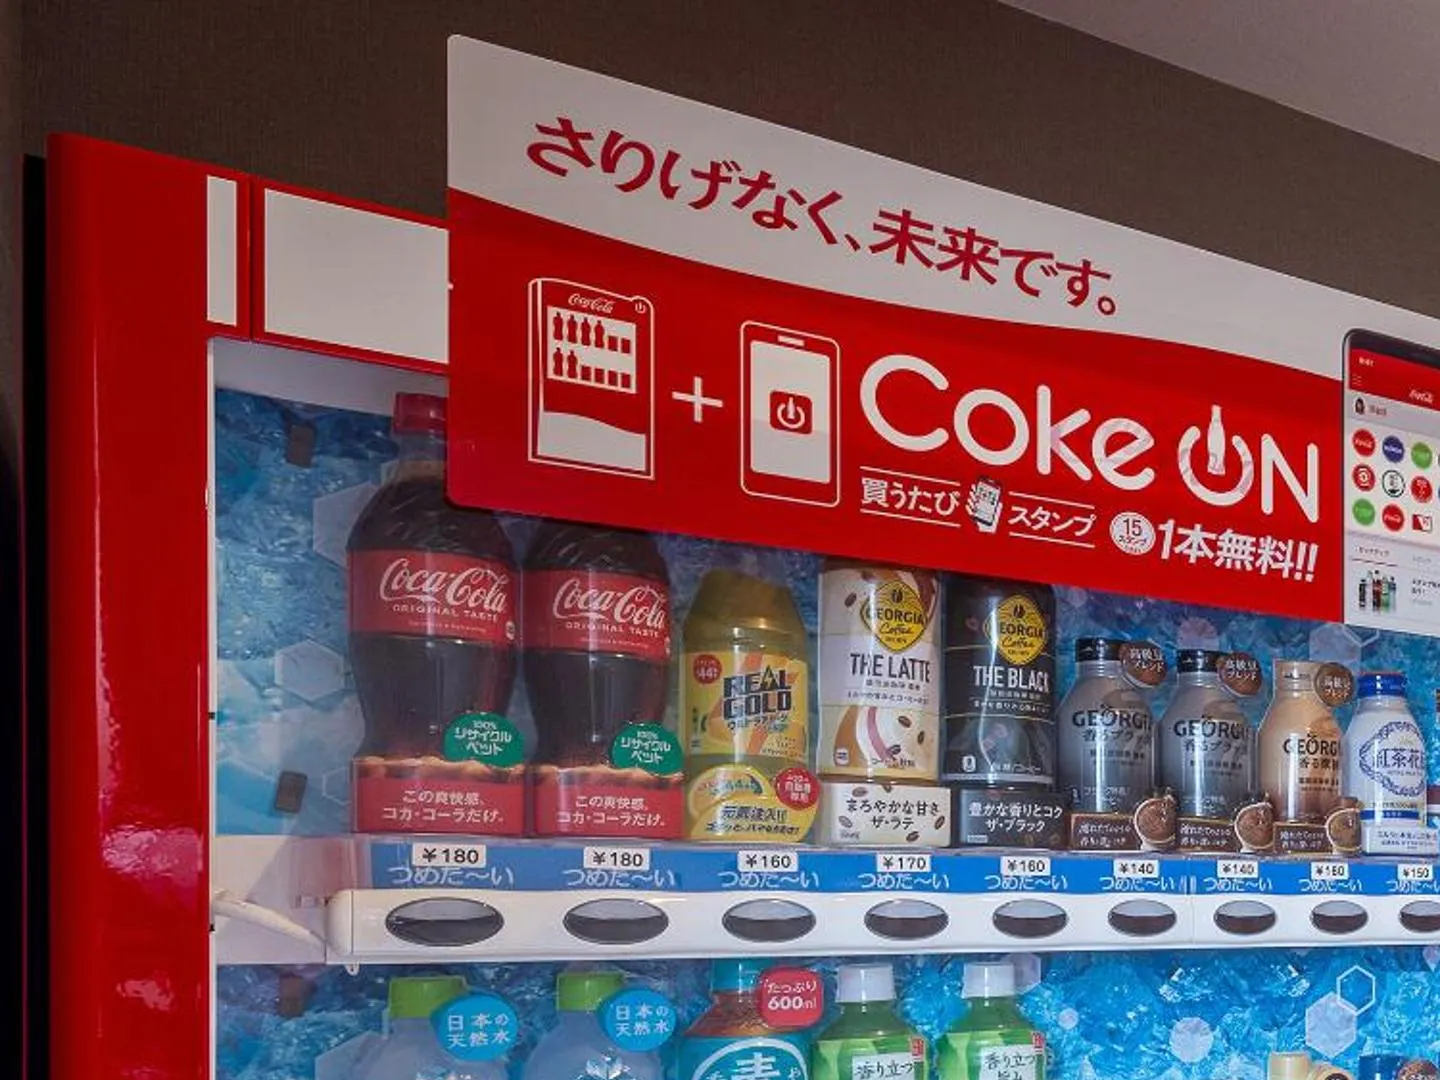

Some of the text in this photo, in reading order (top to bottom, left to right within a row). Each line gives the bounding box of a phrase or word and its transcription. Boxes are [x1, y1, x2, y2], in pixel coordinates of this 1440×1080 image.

[525, 114, 1117, 317] さりげなく、未来です。
[859, 353, 1321, 525] Coke ON
[859, 475, 962, 518] 買うたび
[1007, 502, 1098, 539] スタンプ
[1122, 518, 1143, 537] 15
[1157, 518, 1320, 583] 1本無料!!
[378, 557, 508, 614] Coca-Cola
[552, 577, 667, 631] Coca-Cola
[849, 652, 931, 683] THE LATTE
[973, 664, 1005, 688] THE
[723, 665, 792, 698] REAL
[723, 690, 793, 720] GOLD
[421, 847, 480, 866] ¥180
[591, 850, 644, 868] ¥180
[744, 853, 792, 870] ¥160
[881, 856, 927, 871] ¥170
[1006, 859, 1046, 874] ¥160
[1118, 862, 1155, 875] ¥140
[446, 1012, 511, 1031] 日本の
[615, 1004, 671, 1021] 日本の
[615, 1019, 671, 1037] 天然水
[446, 1030, 510, 1049] 天然水
